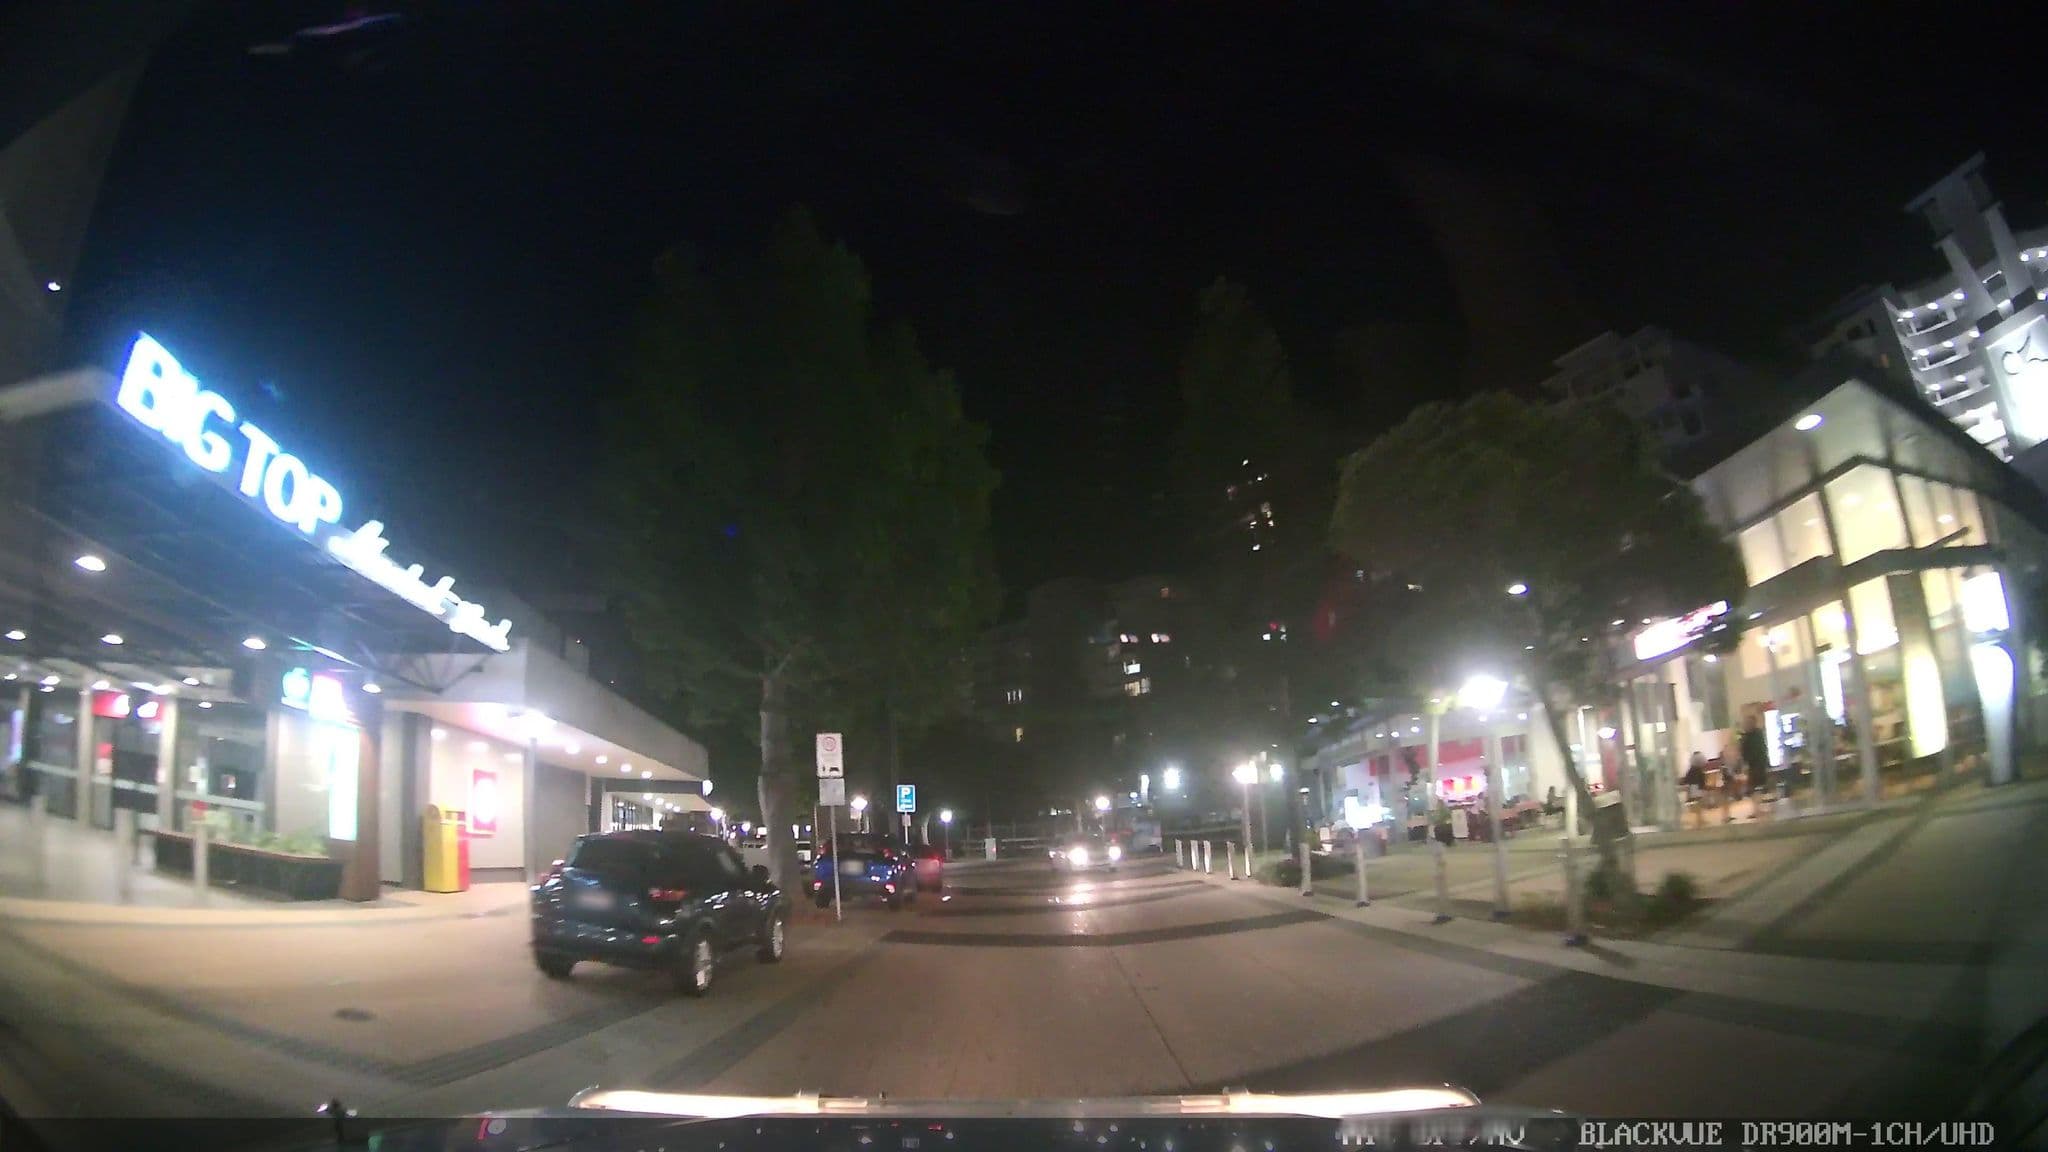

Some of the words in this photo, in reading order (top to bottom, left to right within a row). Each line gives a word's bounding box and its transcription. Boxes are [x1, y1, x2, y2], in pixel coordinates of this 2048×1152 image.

[117, 331, 236, 473] BIG
[239, 421, 343, 534] TOP
[901, 787, 912, 799] P
